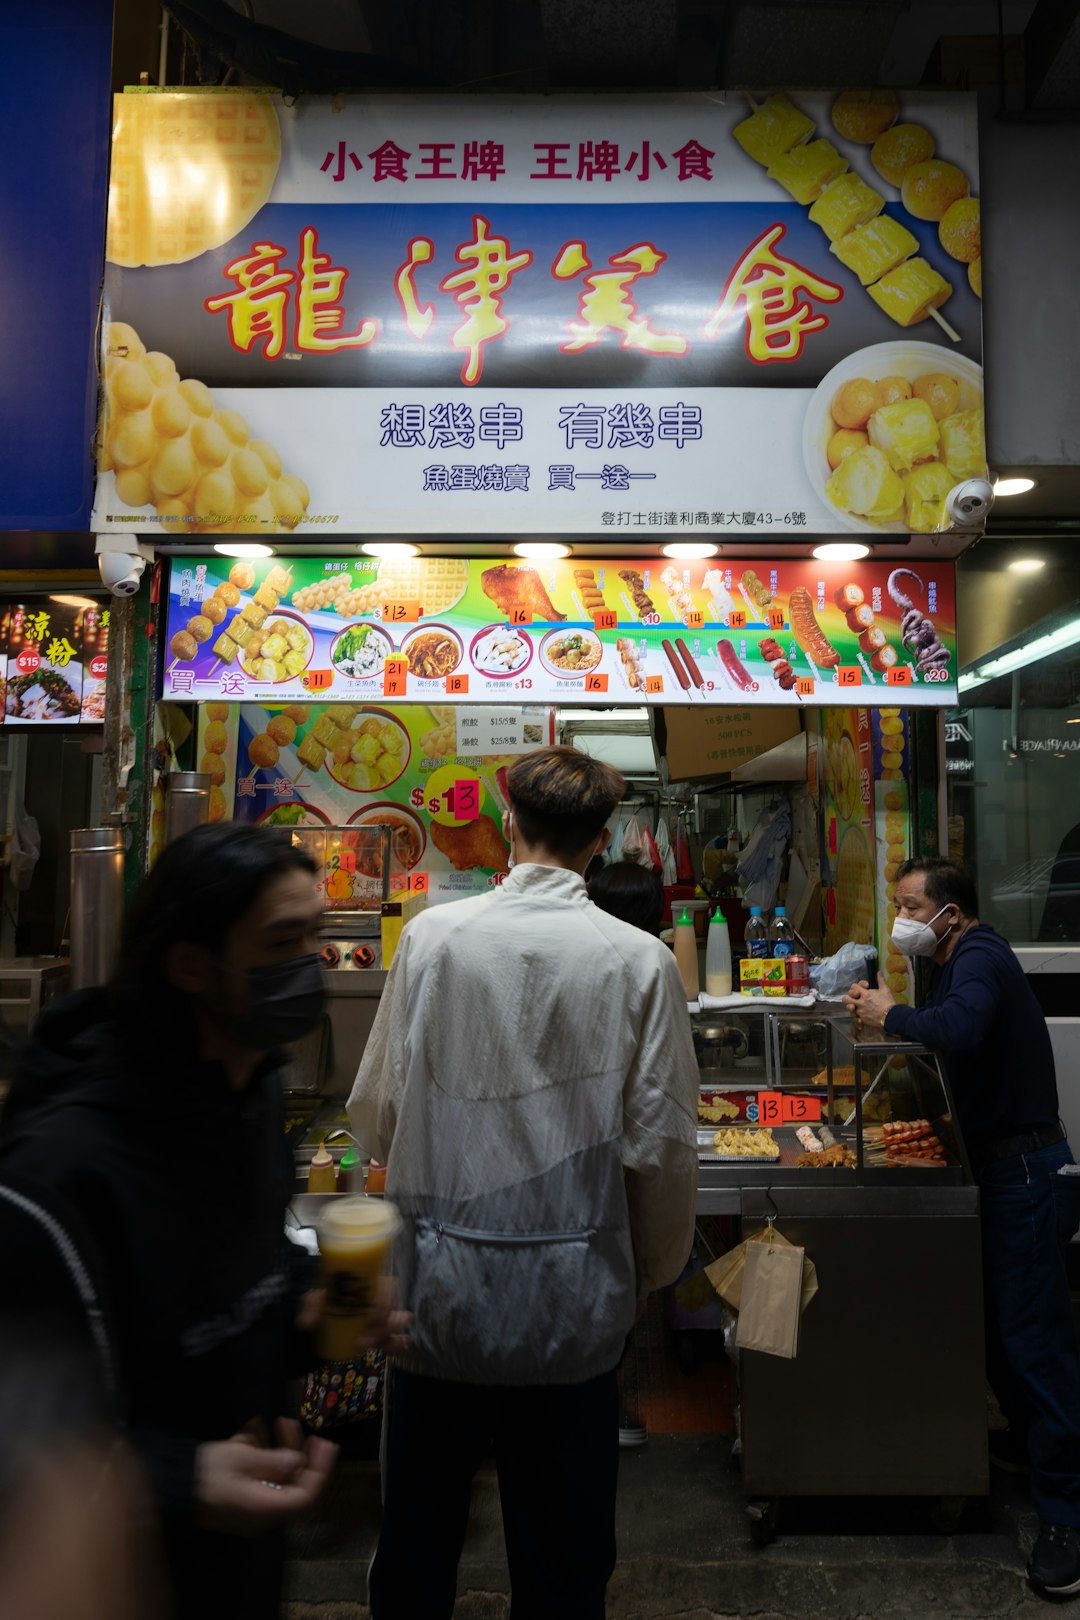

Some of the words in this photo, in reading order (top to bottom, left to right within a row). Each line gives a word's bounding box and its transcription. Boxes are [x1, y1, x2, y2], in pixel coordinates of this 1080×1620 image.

[320, 140, 505, 183] 小食王牌
[530, 139, 716, 182] 王牌小食
[207, 215, 844, 385] 龍津美食
[380, 402, 523, 449] 想幾串
[558, 402, 703, 449] 有幾串
[423, 464, 530, 492] 魚蛋燒賣
[547, 464, 656, 491] 買一送一
[514, 610, 526, 623] 16
[643, 614, 661, 625] $10
[19, 656, 39, 667] $15
[388, 662, 401, 675] 21
[924, 669, 948, 682] $20
[169, 670, 273, 695] 買一送一
[515, 678, 533, 689] $13
[589, 677, 601, 689] 16
[700, 681, 715, 691] $9
[745, 681, 760, 692] $9
[237, 778, 311, 797] 買一送一
